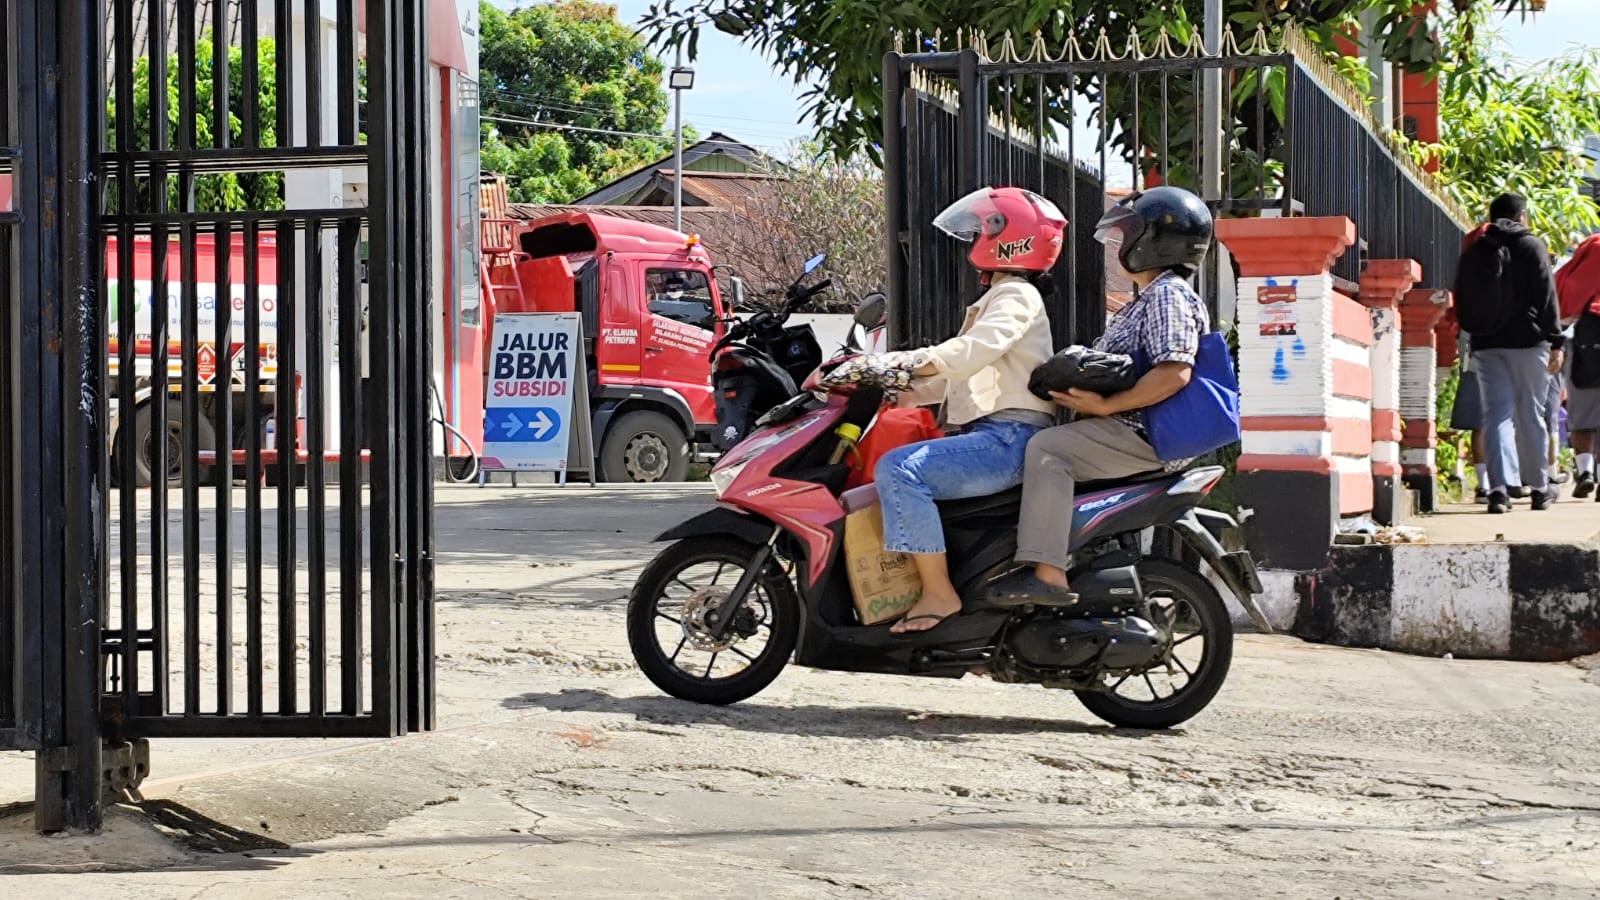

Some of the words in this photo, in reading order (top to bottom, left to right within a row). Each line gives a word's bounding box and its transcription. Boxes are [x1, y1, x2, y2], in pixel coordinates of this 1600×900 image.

[996, 236, 1035, 263] NHK
[498, 332, 569, 351] JALUR
[494, 352, 567, 379] BBM
[493, 380, 567, 397] SUBSIDI
[747, 483, 782, 497] HONDA
